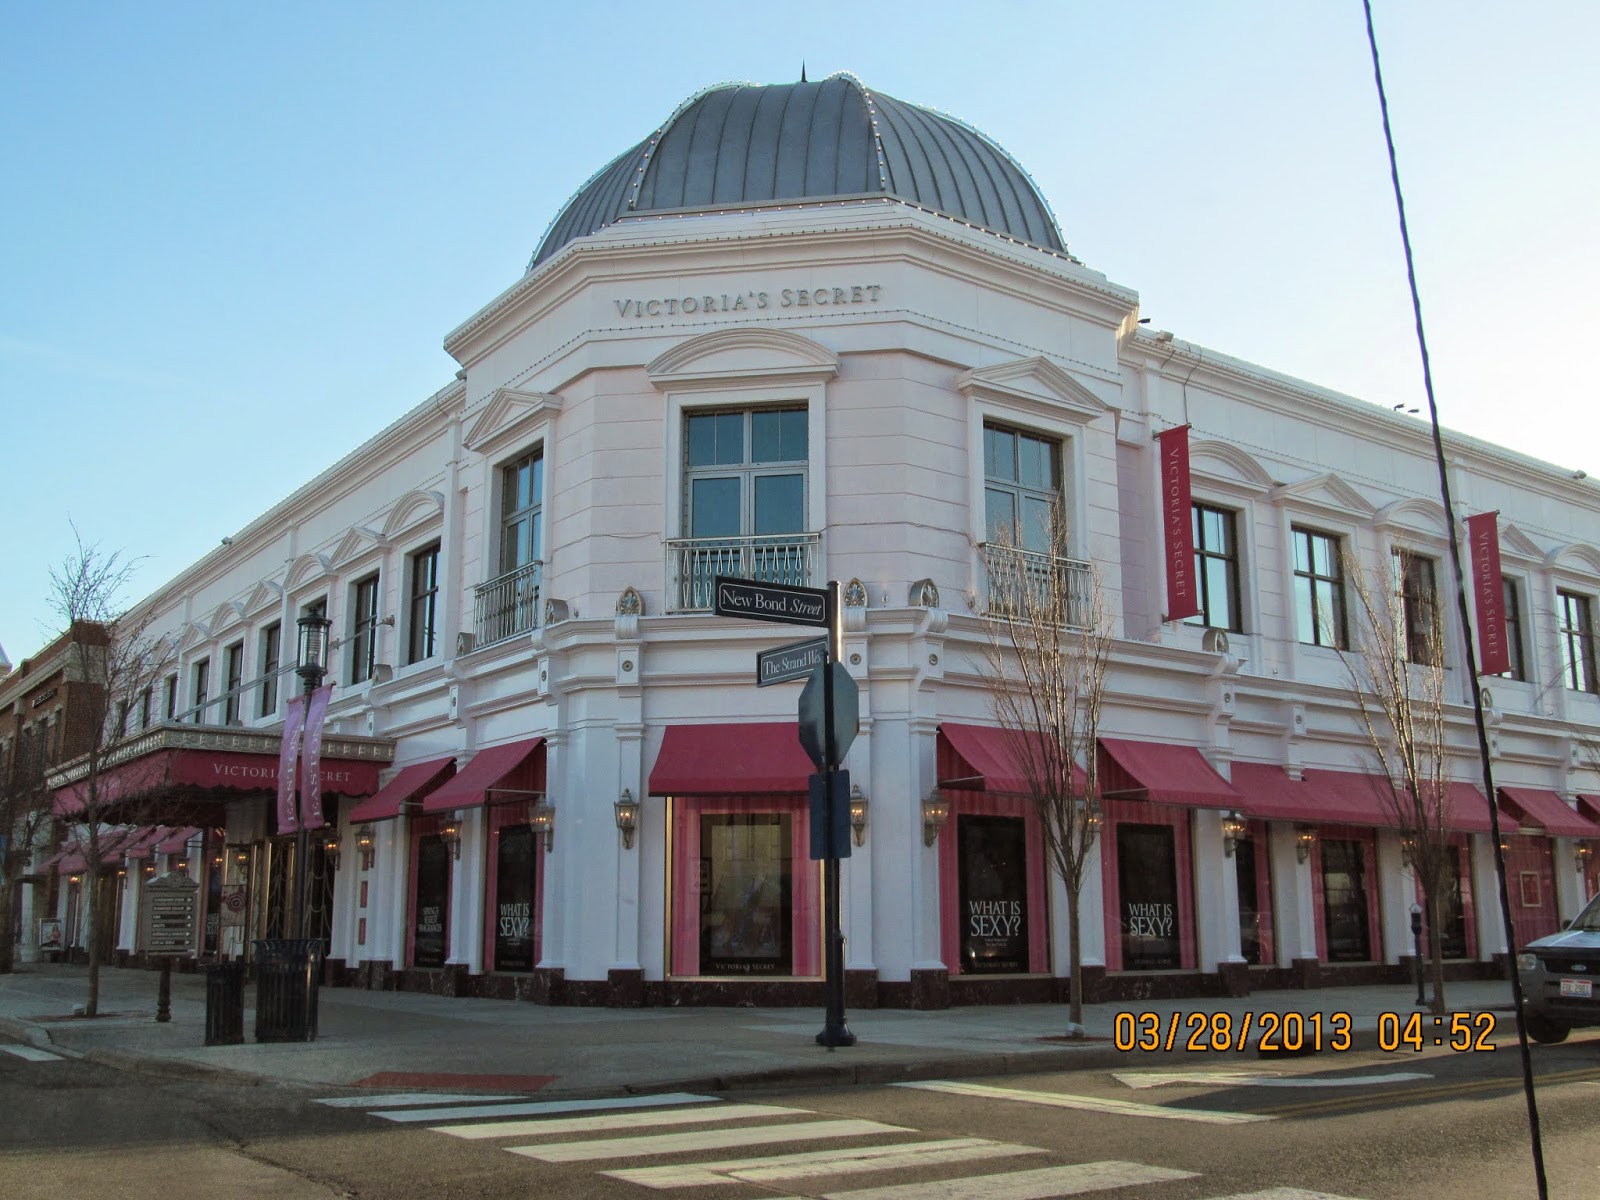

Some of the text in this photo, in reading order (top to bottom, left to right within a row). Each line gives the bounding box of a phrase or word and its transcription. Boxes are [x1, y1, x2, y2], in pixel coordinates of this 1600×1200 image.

[613, 284, 882, 318] VICTORIA'S SECRET
[1169, 447, 1186, 597] VICTORIA'S SECRET
[722, 589, 822, 616] New Bond Street
[1479, 531, 1499, 656] VICTORIA'S SECRET
[763, 660, 780, 675] The
[782, 655, 807, 672] Strand
[213, 763, 351, 782] VICTORI CRET
[287, 724, 300, 821] EASTON
[310, 720, 324, 816] EASTON
[500, 903, 530, 916] WHAT IS
[969, 900, 1021, 915] WHAT IS
[1128, 903, 1173, 917] WHAT IS
[500, 917, 530, 937] SEXY?
[970, 915, 1021, 937] SEXY?
[1130, 916, 1173, 936] SEXY?
